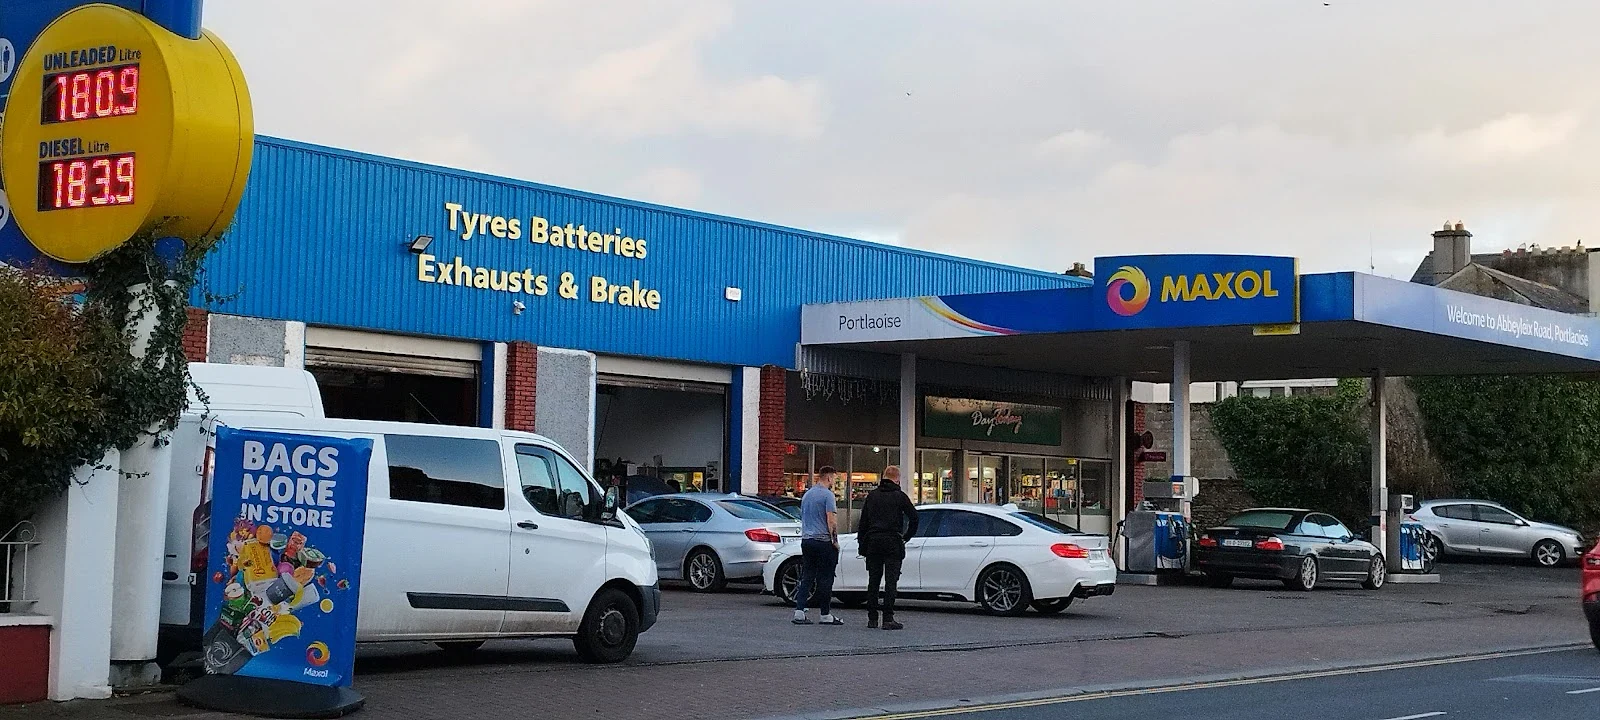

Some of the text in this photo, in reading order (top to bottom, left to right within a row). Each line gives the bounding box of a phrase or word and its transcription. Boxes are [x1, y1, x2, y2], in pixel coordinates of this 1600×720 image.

[43, 45, 142, 71] UNLEADED Litre
[57, 67, 138, 121] 180.9
[39, 137, 110, 158] DIESEL Litre
[53, 156, 135, 208] 183.9
[445, 202, 647, 260] Tyres Batteries
[417, 254, 662, 310] Exhausts & Brake
[1160, 270, 1279, 304] MAXOL
[838, 314, 902, 332] Portlaoise
[1446, 304, 1589, 347] Welcome to Abbeyleix Road, Portlaoise
[242, 440, 340, 478] BAGS
[241, 472, 337, 508] MORE
[240, 502, 334, 528] IN STORE
[303, 667, 329, 678] Maxol
